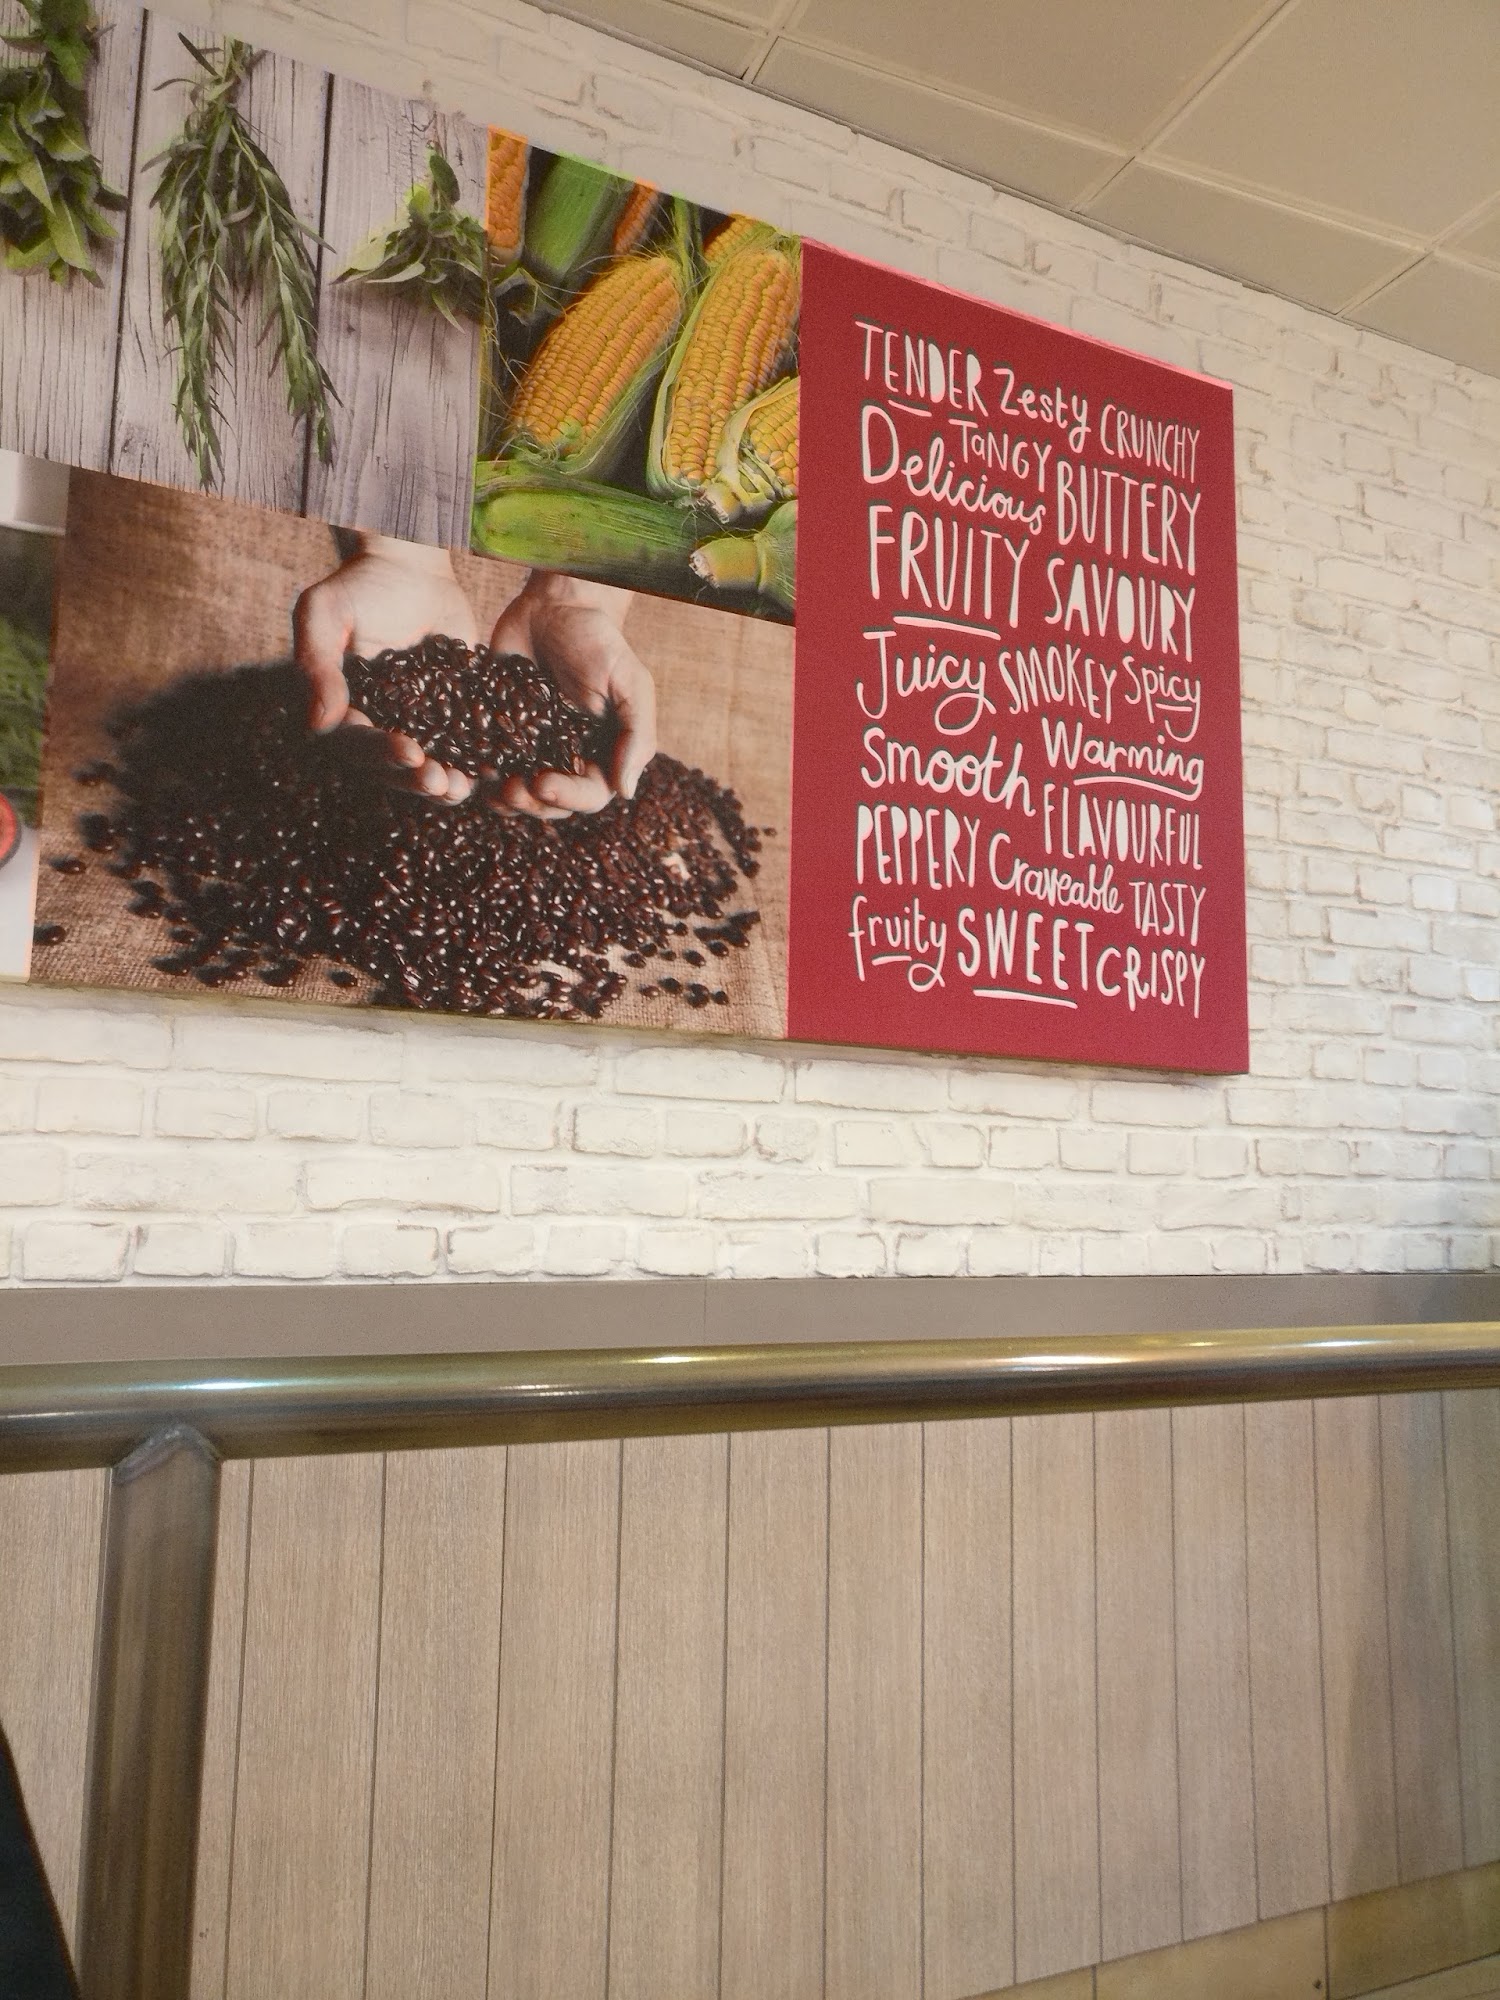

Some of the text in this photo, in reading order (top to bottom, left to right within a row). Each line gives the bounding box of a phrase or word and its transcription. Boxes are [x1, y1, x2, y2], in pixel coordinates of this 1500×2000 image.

[856, 322, 1199, 483] TENDER Zesty CRUNCHY
[862, 405, 1200, 576] Delicious BUTTERY
[869, 506, 1195, 662] FRUITY SAVOURY
[856, 631, 1200, 742] Juicy SMOKEY Spicy
[861, 717, 1204, 816] Smooth Warming
[1044, 783, 1202, 870] FLAVOURFUL
[857, 805, 1206, 946] PEPPERY Craveable TASTY
[849, 896, 1205, 1018] fruity SWEET CRISPY
